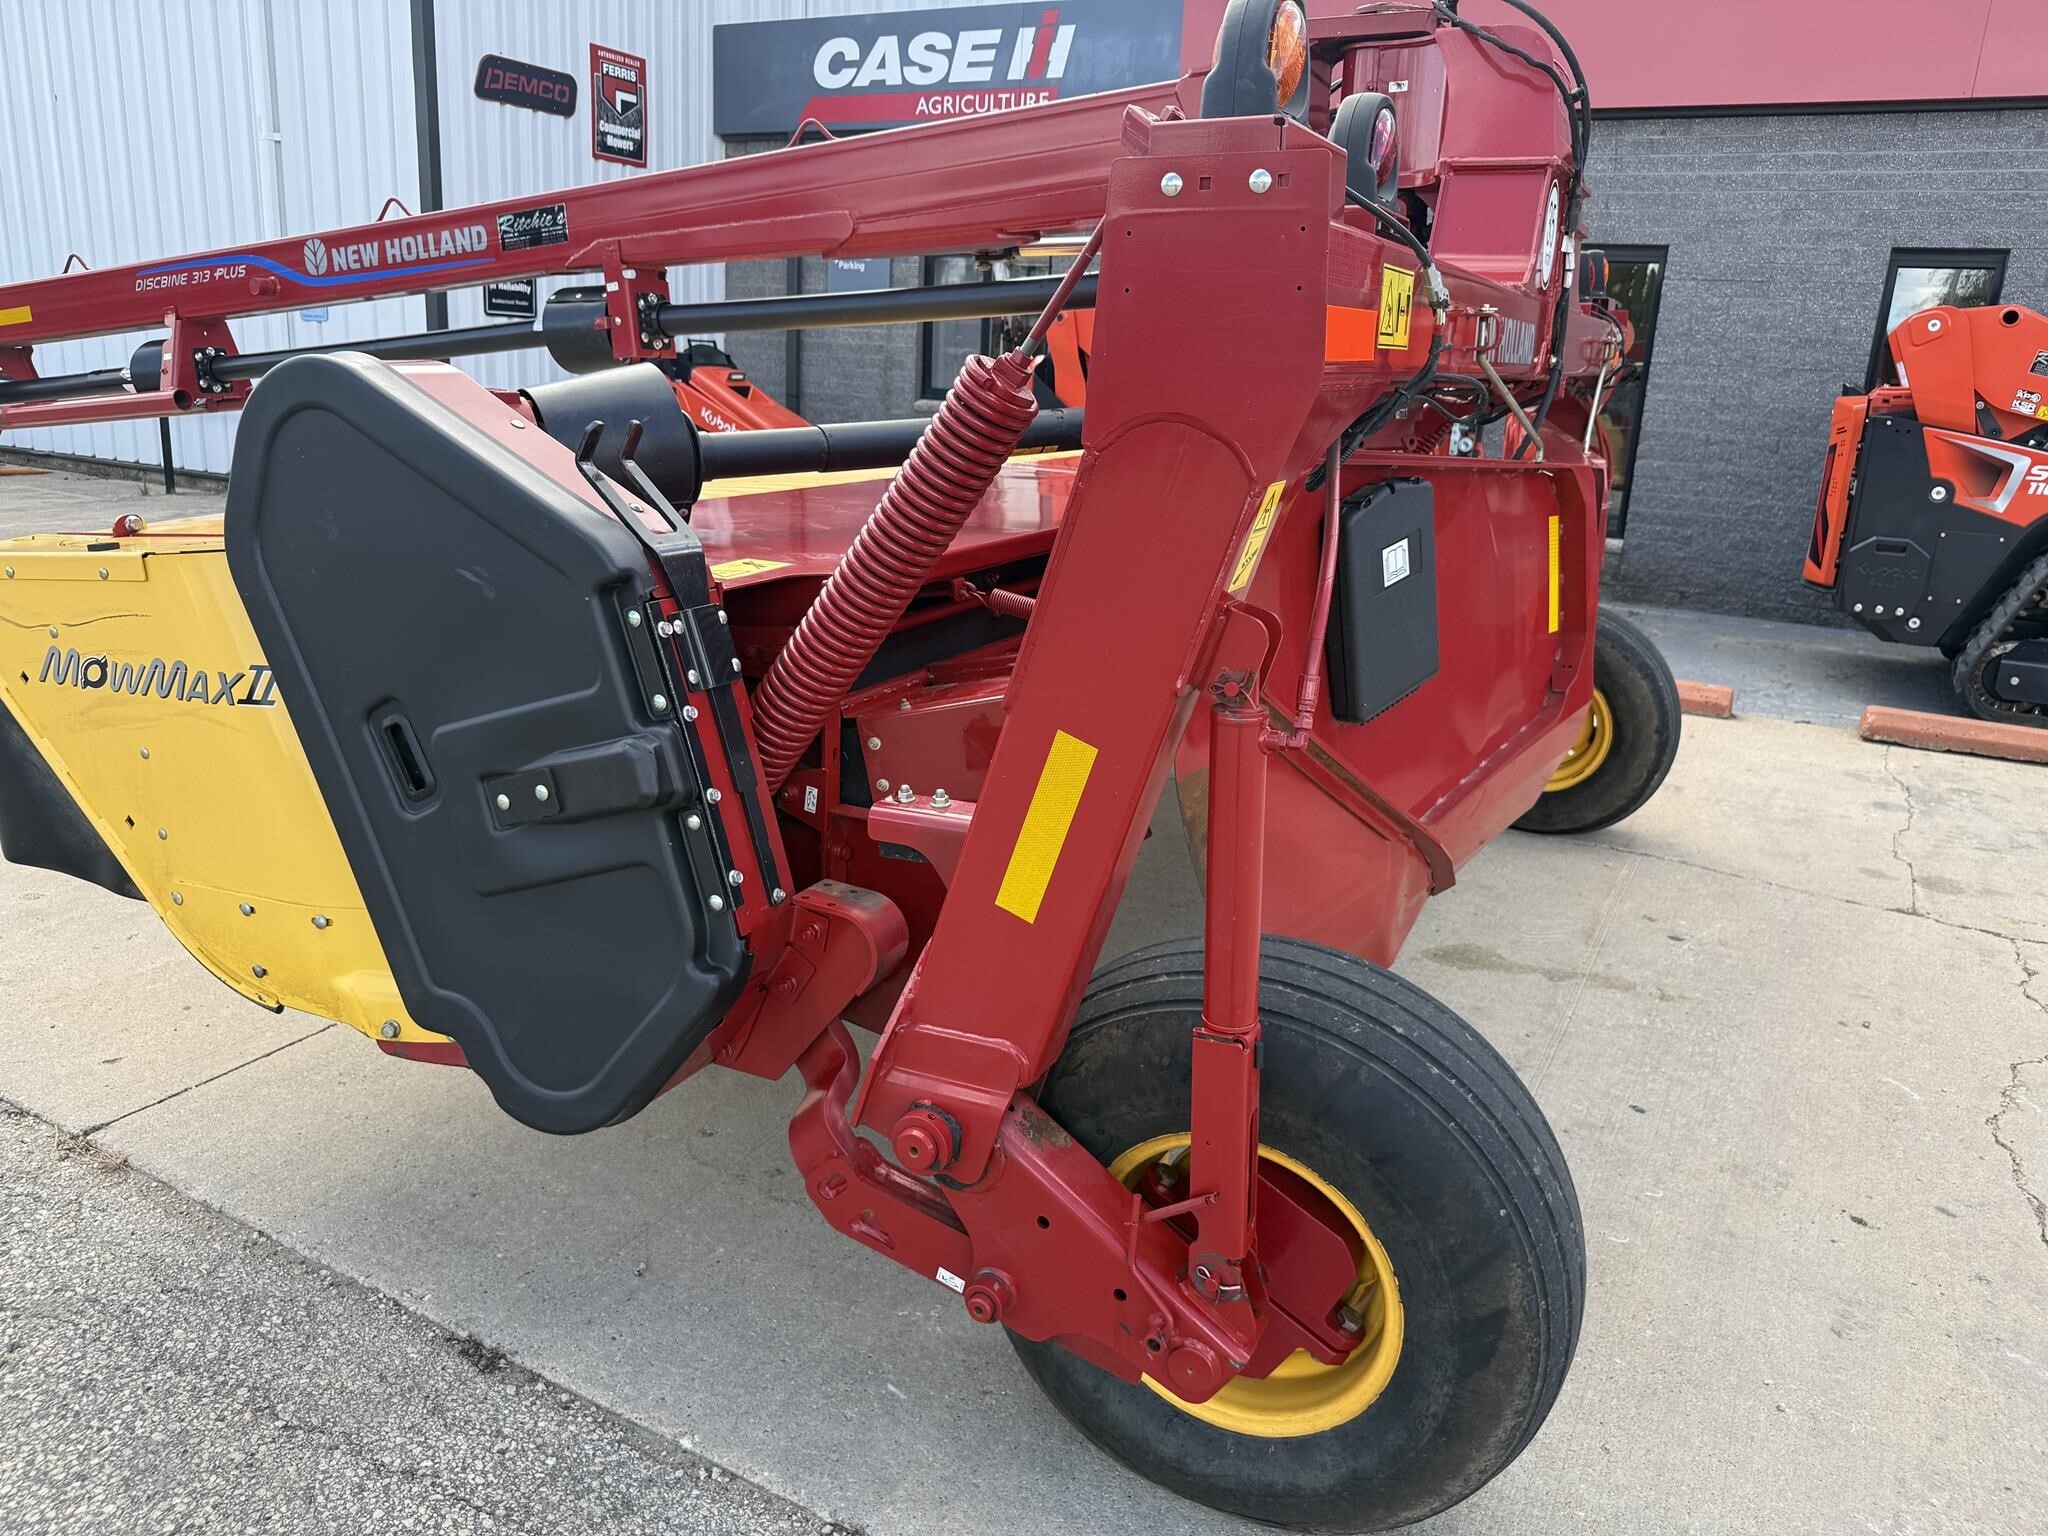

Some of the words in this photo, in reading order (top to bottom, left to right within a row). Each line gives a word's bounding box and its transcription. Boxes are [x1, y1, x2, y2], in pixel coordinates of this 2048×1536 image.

[813, 31, 1002, 89] CASE
[602, 62, 637, 83] FERRIS
[484, 67, 570, 104] DEMCO
[915, 92, 1050, 115] AGRICULTURE
[599, 119, 641, 140] Commercial
[606, 134, 634, 152] Mowers
[499, 206, 566, 233] Ritchie's
[331, 242, 379, 272] NEW
[385, 225, 488, 264] HOLLAND
[838, 260, 865, 272] Parking
[135, 273, 188, 292] DISCBINE
[191, 270, 211, 284] 313
[701, 406, 737, 432] Kubot
